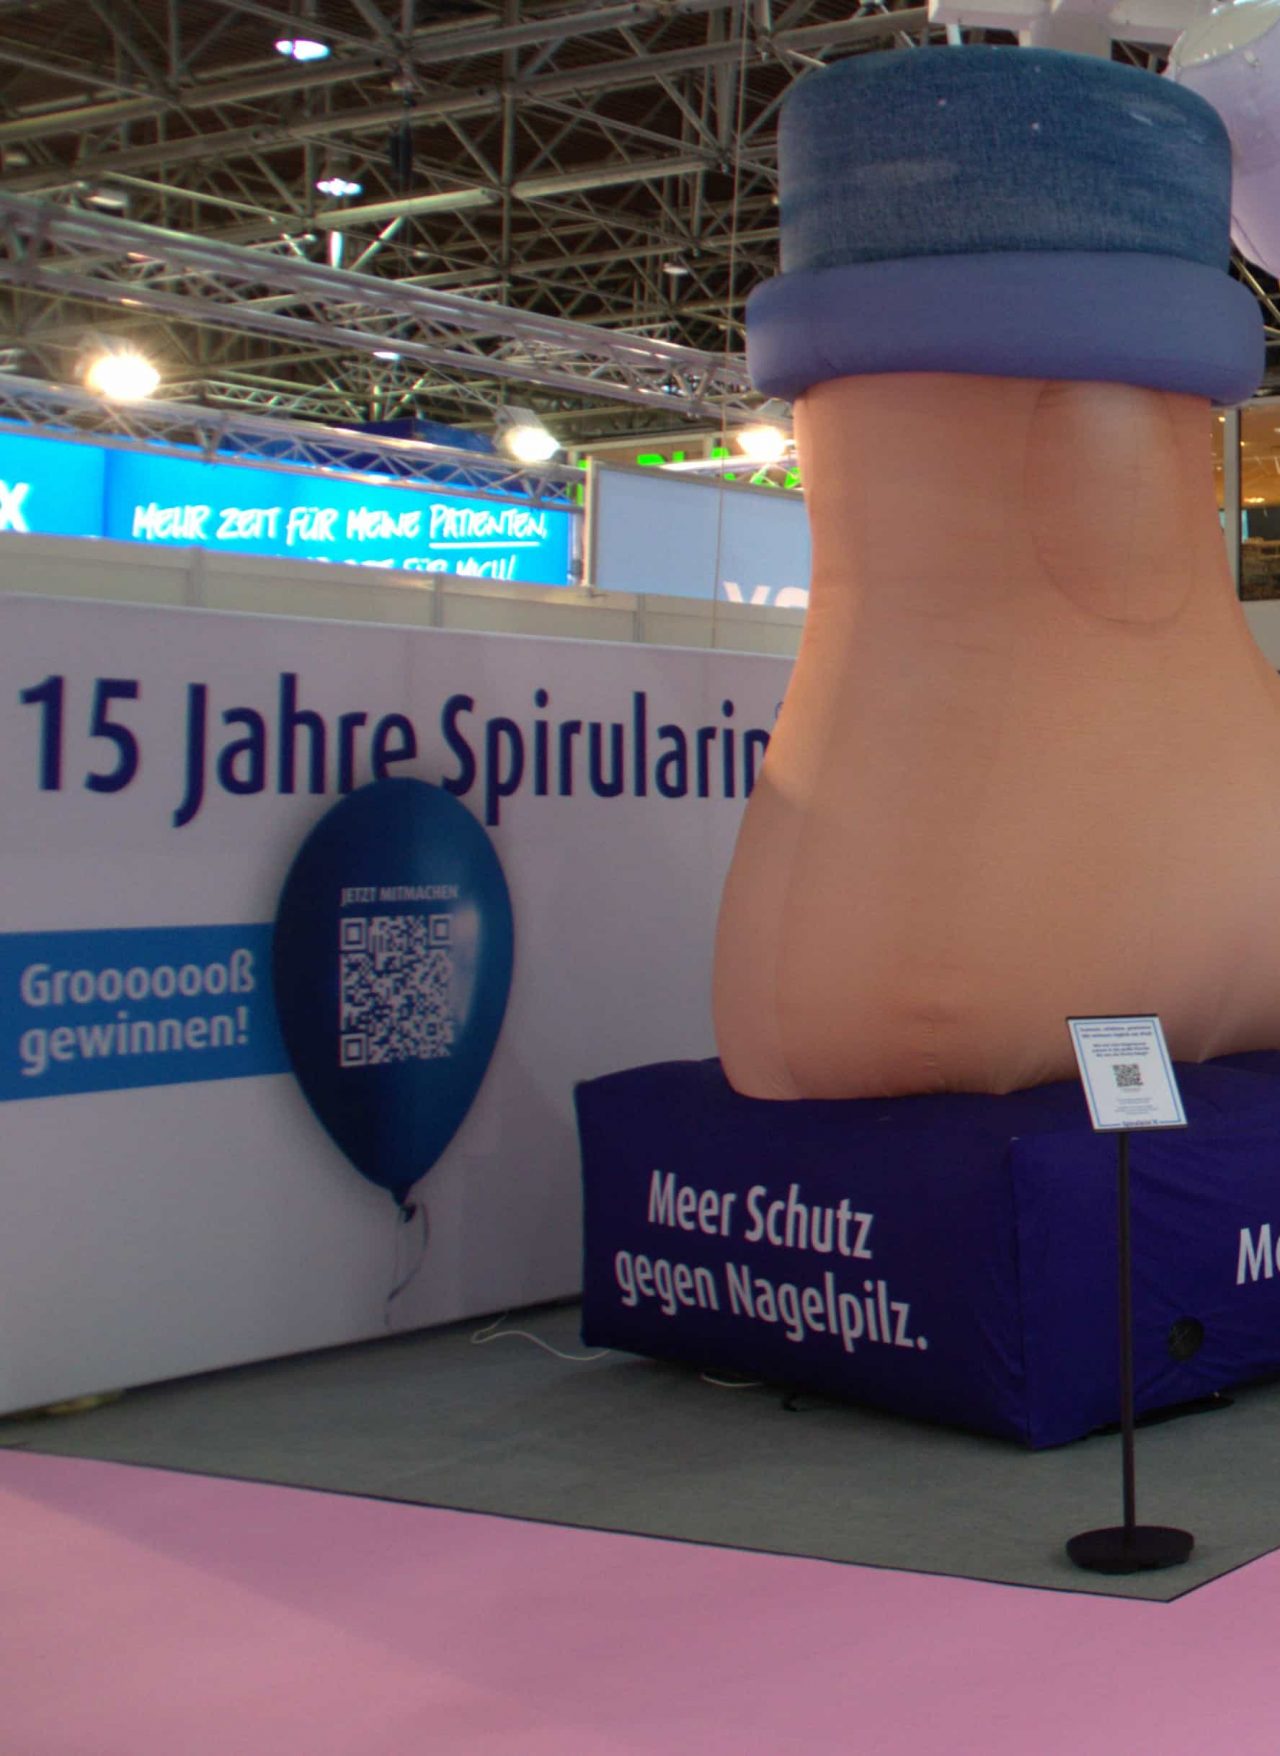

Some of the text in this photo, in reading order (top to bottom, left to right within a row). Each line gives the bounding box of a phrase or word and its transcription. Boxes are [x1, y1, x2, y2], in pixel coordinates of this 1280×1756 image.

[18, 671, 774, 829] 15 Jahre Spirularin
[341, 884, 459, 908] JETZT MITMACHEN
[20, 948, 256, 1007] Grooooooß
[18, 1005, 249, 1077] gewinnen!
[647, 1169, 874, 1260] Meer Schutz
[614, 1250, 929, 1353] gegen Nagelpilz.
